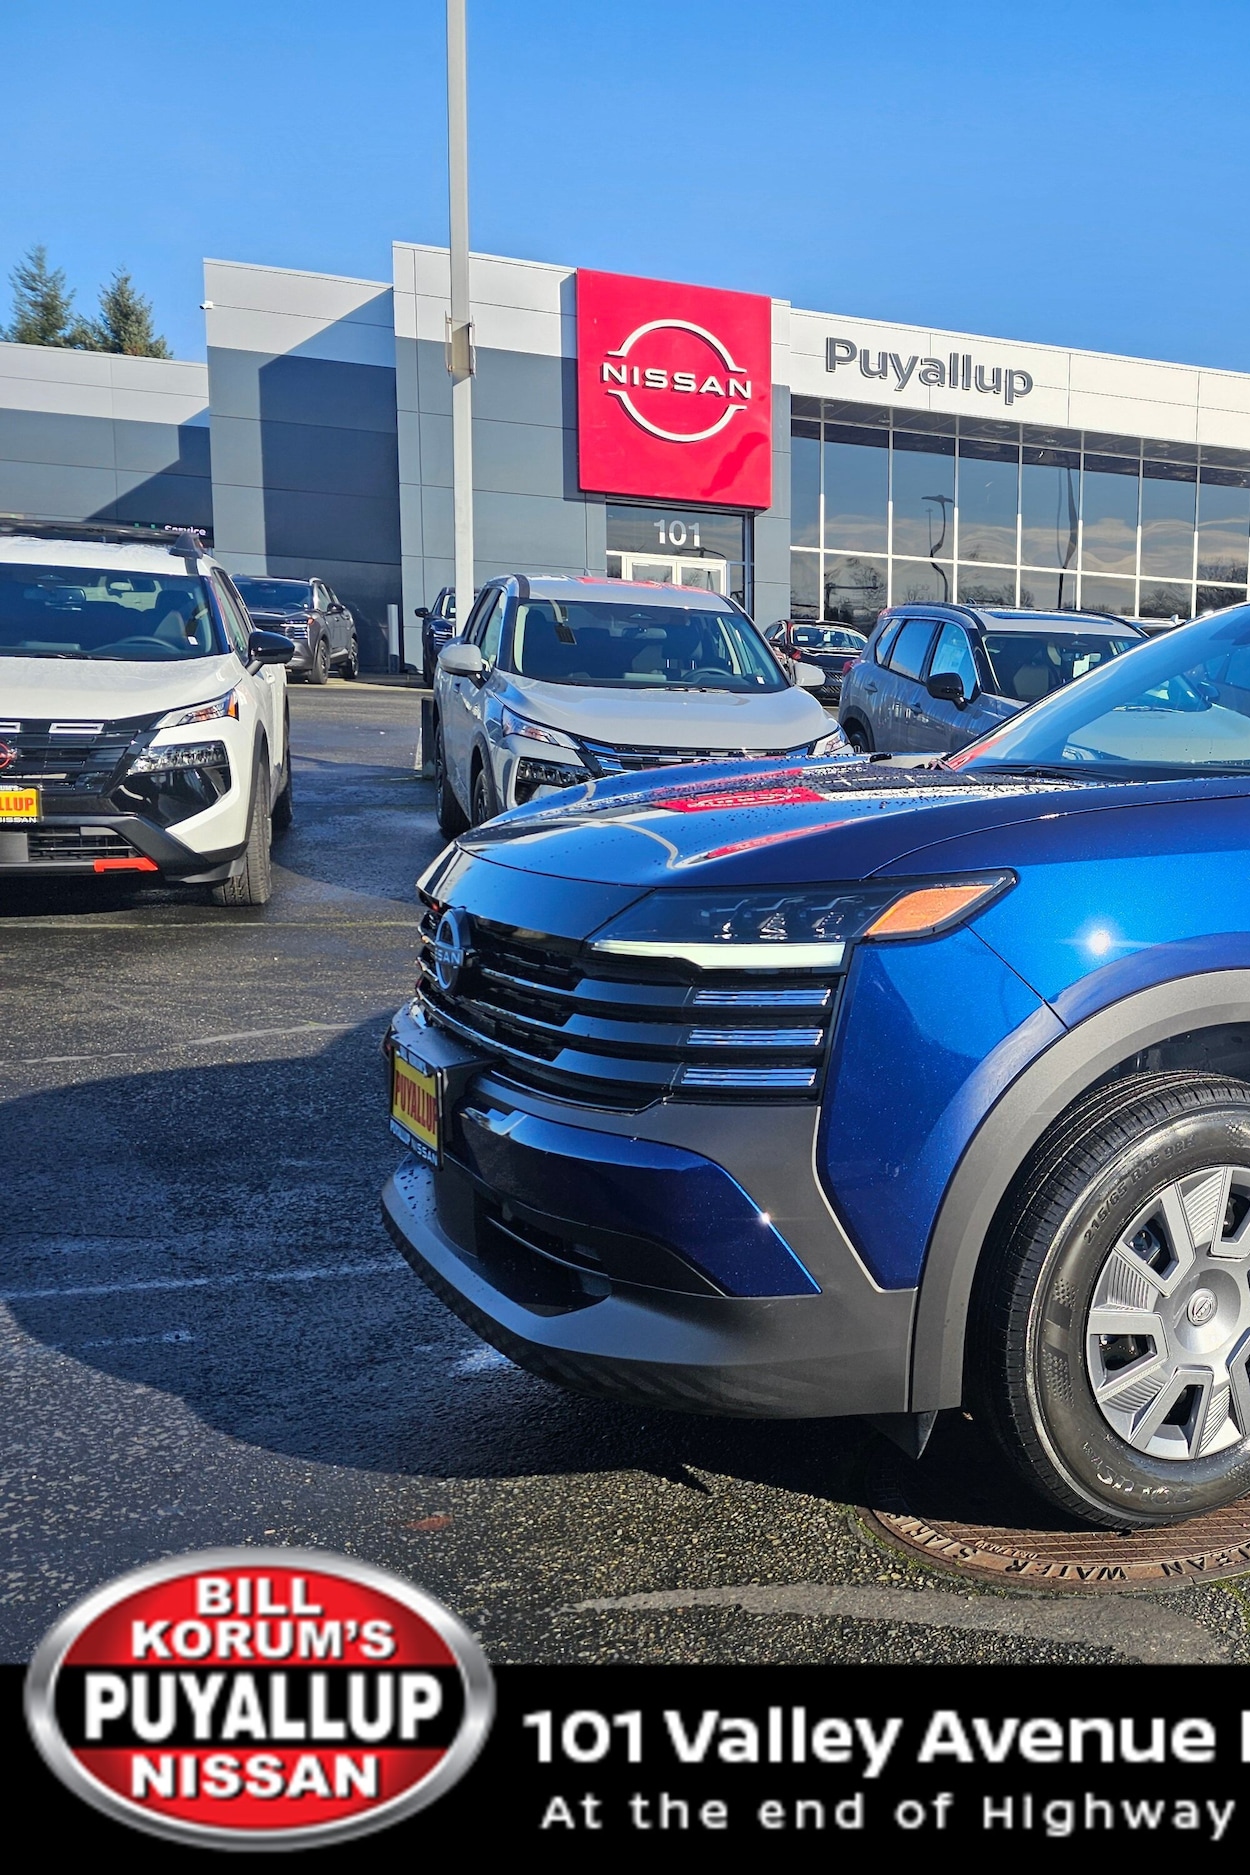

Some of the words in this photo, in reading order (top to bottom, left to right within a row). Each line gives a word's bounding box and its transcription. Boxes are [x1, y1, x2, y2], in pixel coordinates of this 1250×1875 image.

[601, 360, 753, 400] NISSAN
[825, 336, 1033, 405] Puyallup
[653, 519, 701, 547] 101
[1083, 1180, 1129, 1246] 215/65
[1004, 1559, 1129, 1581] WATER
